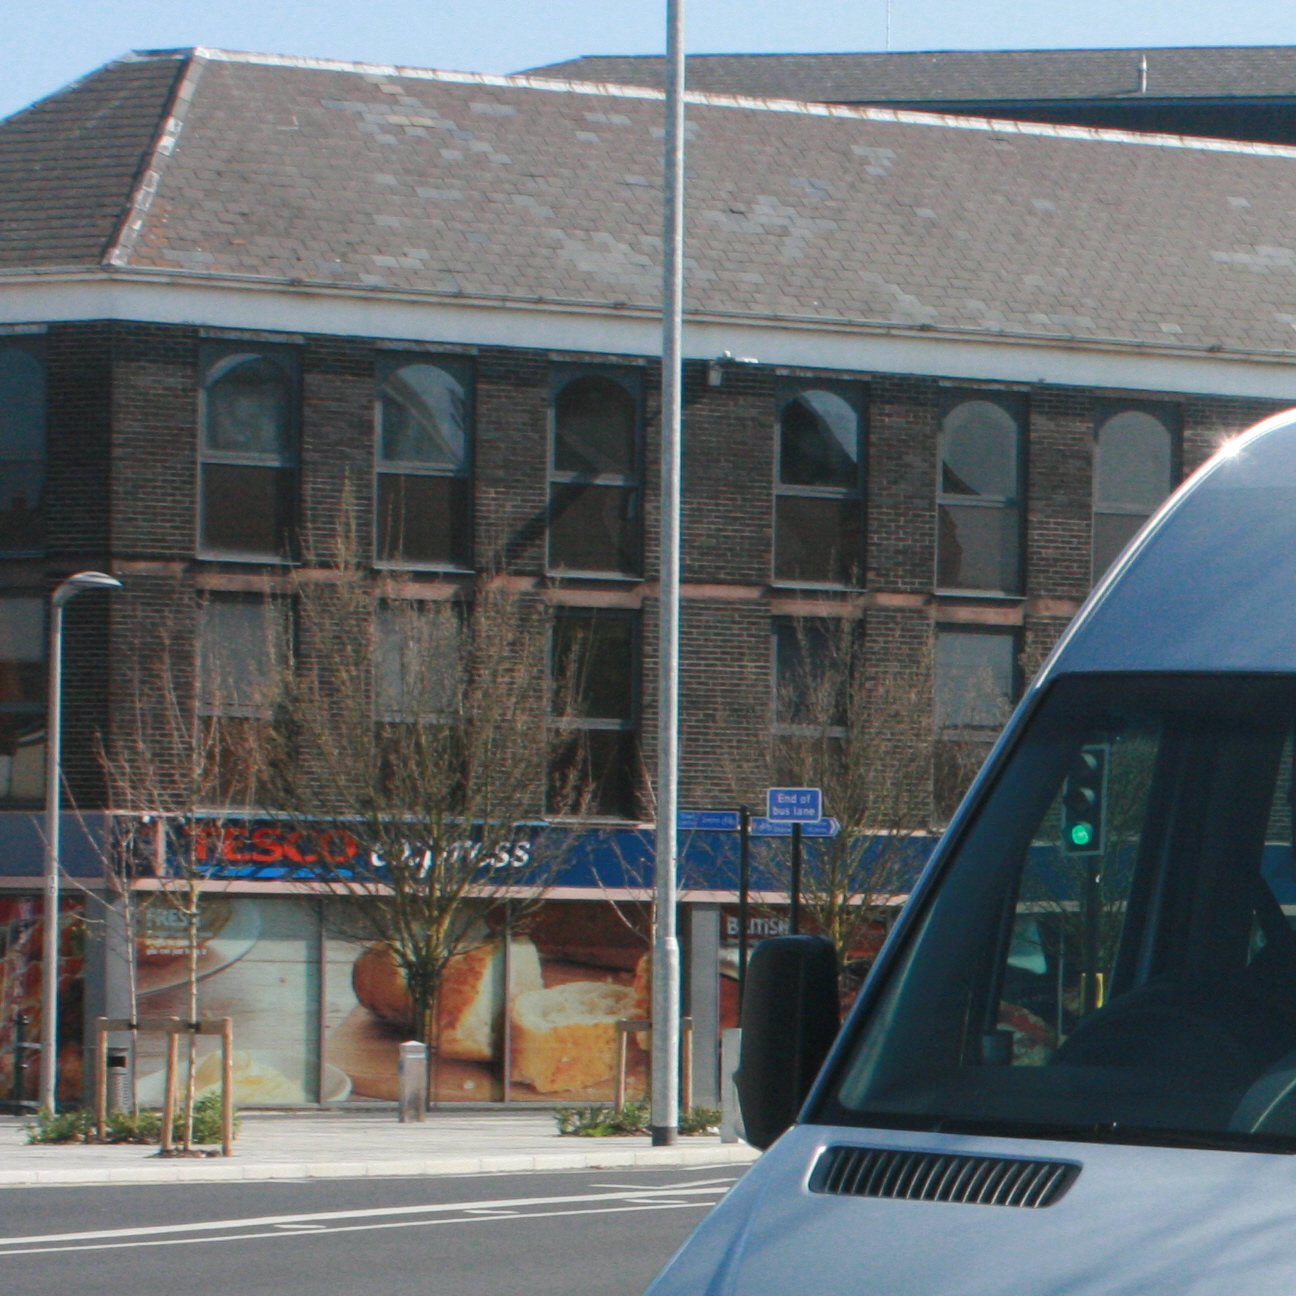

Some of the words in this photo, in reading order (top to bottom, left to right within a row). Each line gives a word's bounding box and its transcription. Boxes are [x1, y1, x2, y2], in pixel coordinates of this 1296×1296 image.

[777, 793, 797, 804] End
[800, 793, 811, 804] of
[772, 806, 790, 816] bus
[793, 806, 815, 816] lane
[184, 824, 359, 863] TESCO
[727, 916, 790, 935] BITISH
